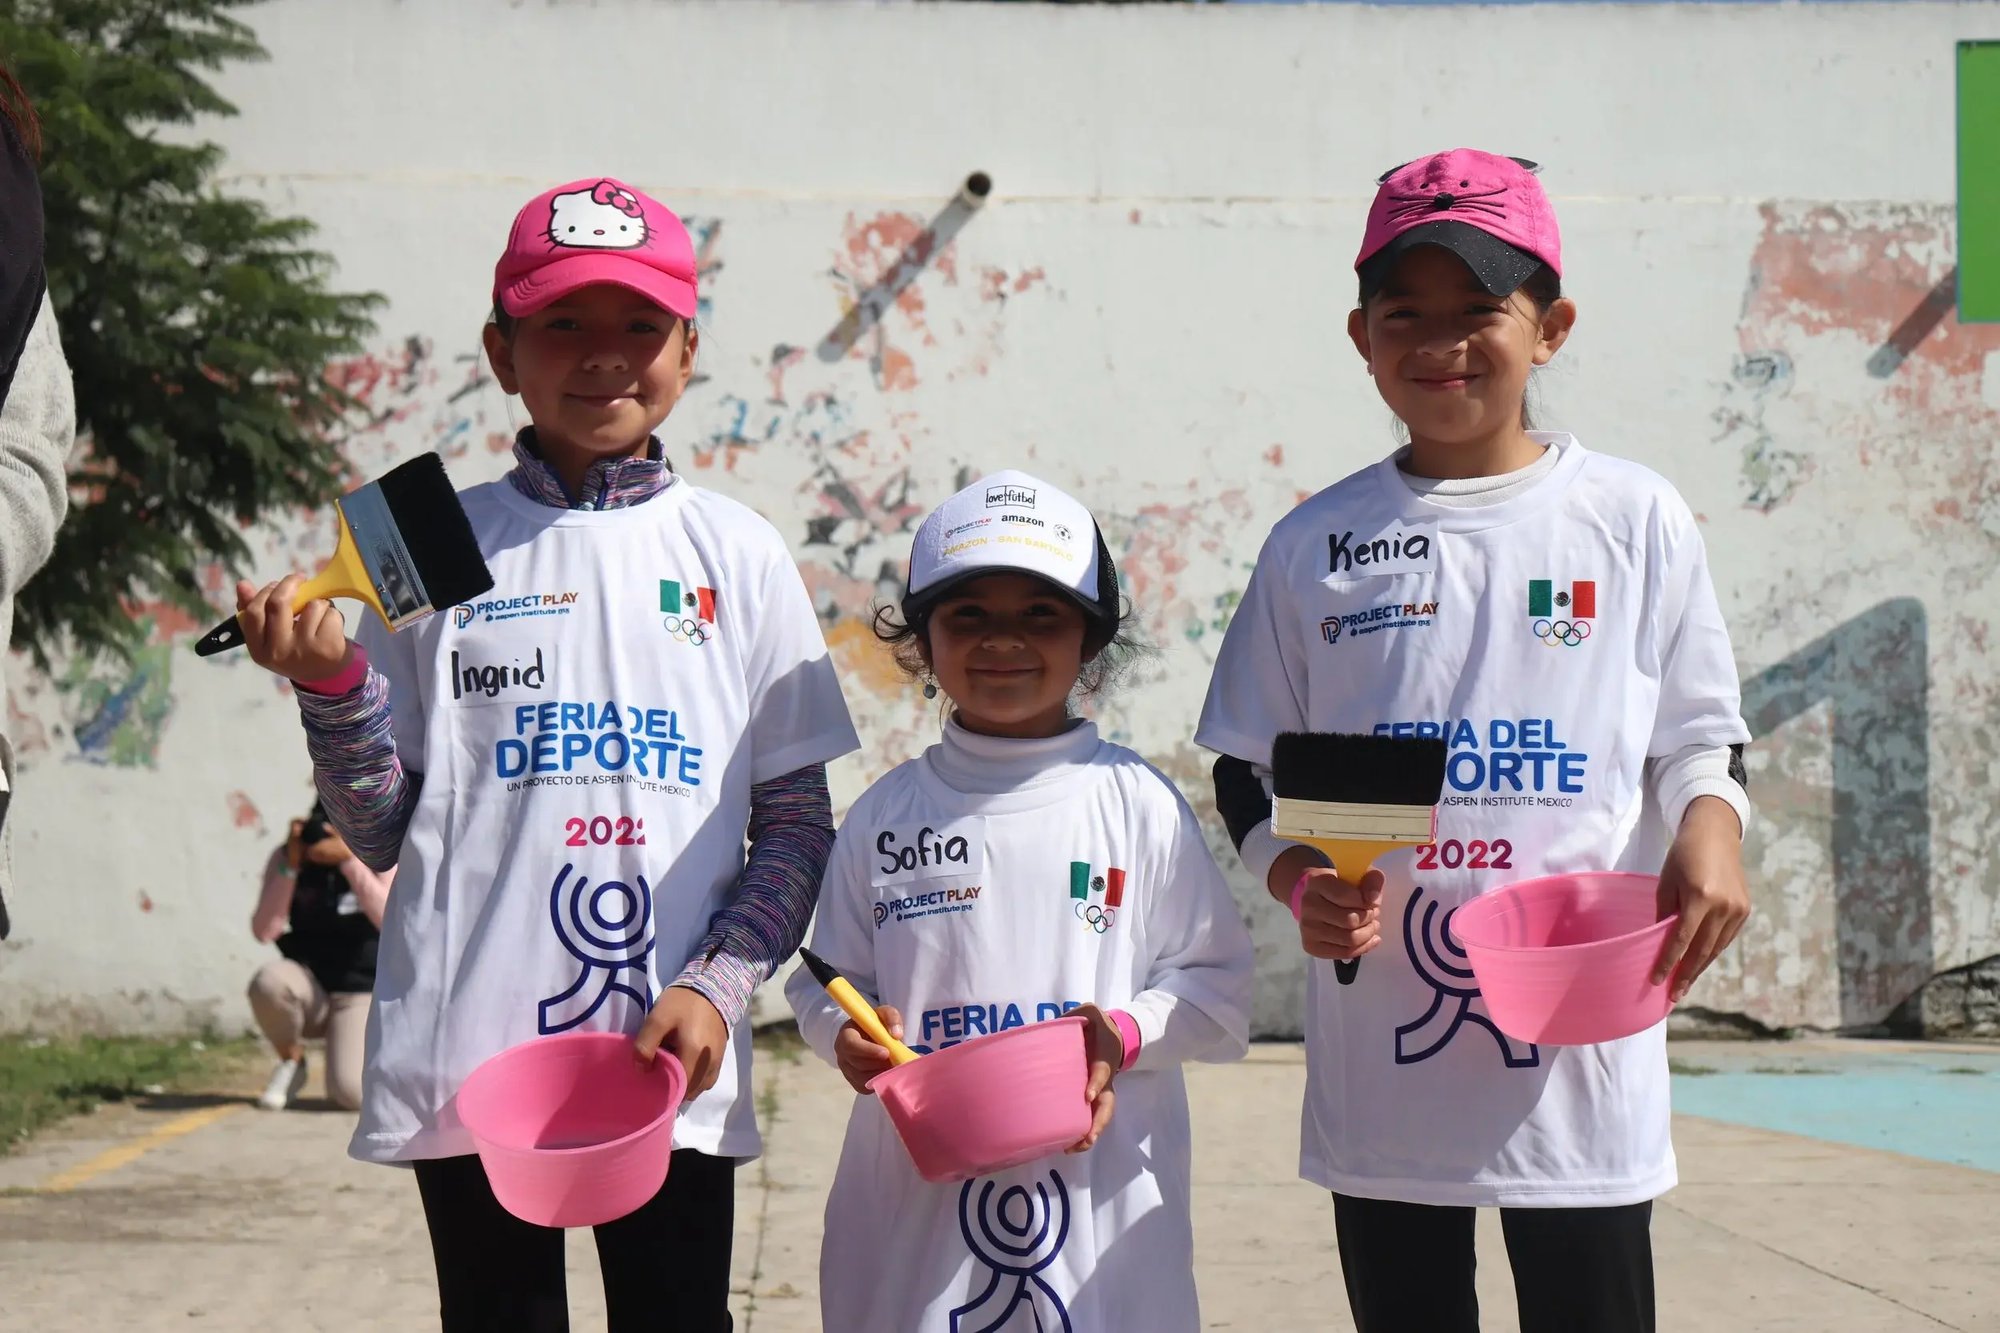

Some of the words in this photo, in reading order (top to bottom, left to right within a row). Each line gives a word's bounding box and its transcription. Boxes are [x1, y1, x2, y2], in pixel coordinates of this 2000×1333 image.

[1001, 514, 1044, 528] amazon
[1328, 531, 1430, 572] Kenia
[495, 611, 520, 622] aspen
[521, 608, 557, 617] institute
[1358, 624, 1381, 635] aspen
[1382, 619, 1416, 629] institute
[451, 647, 545, 699] Ingrid
[515, 701, 622, 735] FERIA
[1490, 719, 1566, 749] DEL
[496, 731, 702, 786] DEPORTE
[1446, 752, 1588, 793] ORTE
[507, 782, 521, 792] UN
[523, 775, 573, 789] PROYECTO
[576, 775, 589, 785] DE
[591, 774, 624, 785] ASPEN
[659, 784, 691, 798] MEXICO
[1442, 797, 1478, 807] ASPEN
[1480, 796, 1535, 807] INSTITUTE
[1536, 798, 1573, 808] MEXICO
[876, 827, 968, 874] Sofia
[1415, 838, 1513, 870] 2022
[904, 911, 926, 920] aspen
[927, 905, 960, 915] institute
[922, 1003, 1025, 1041] FERIA
